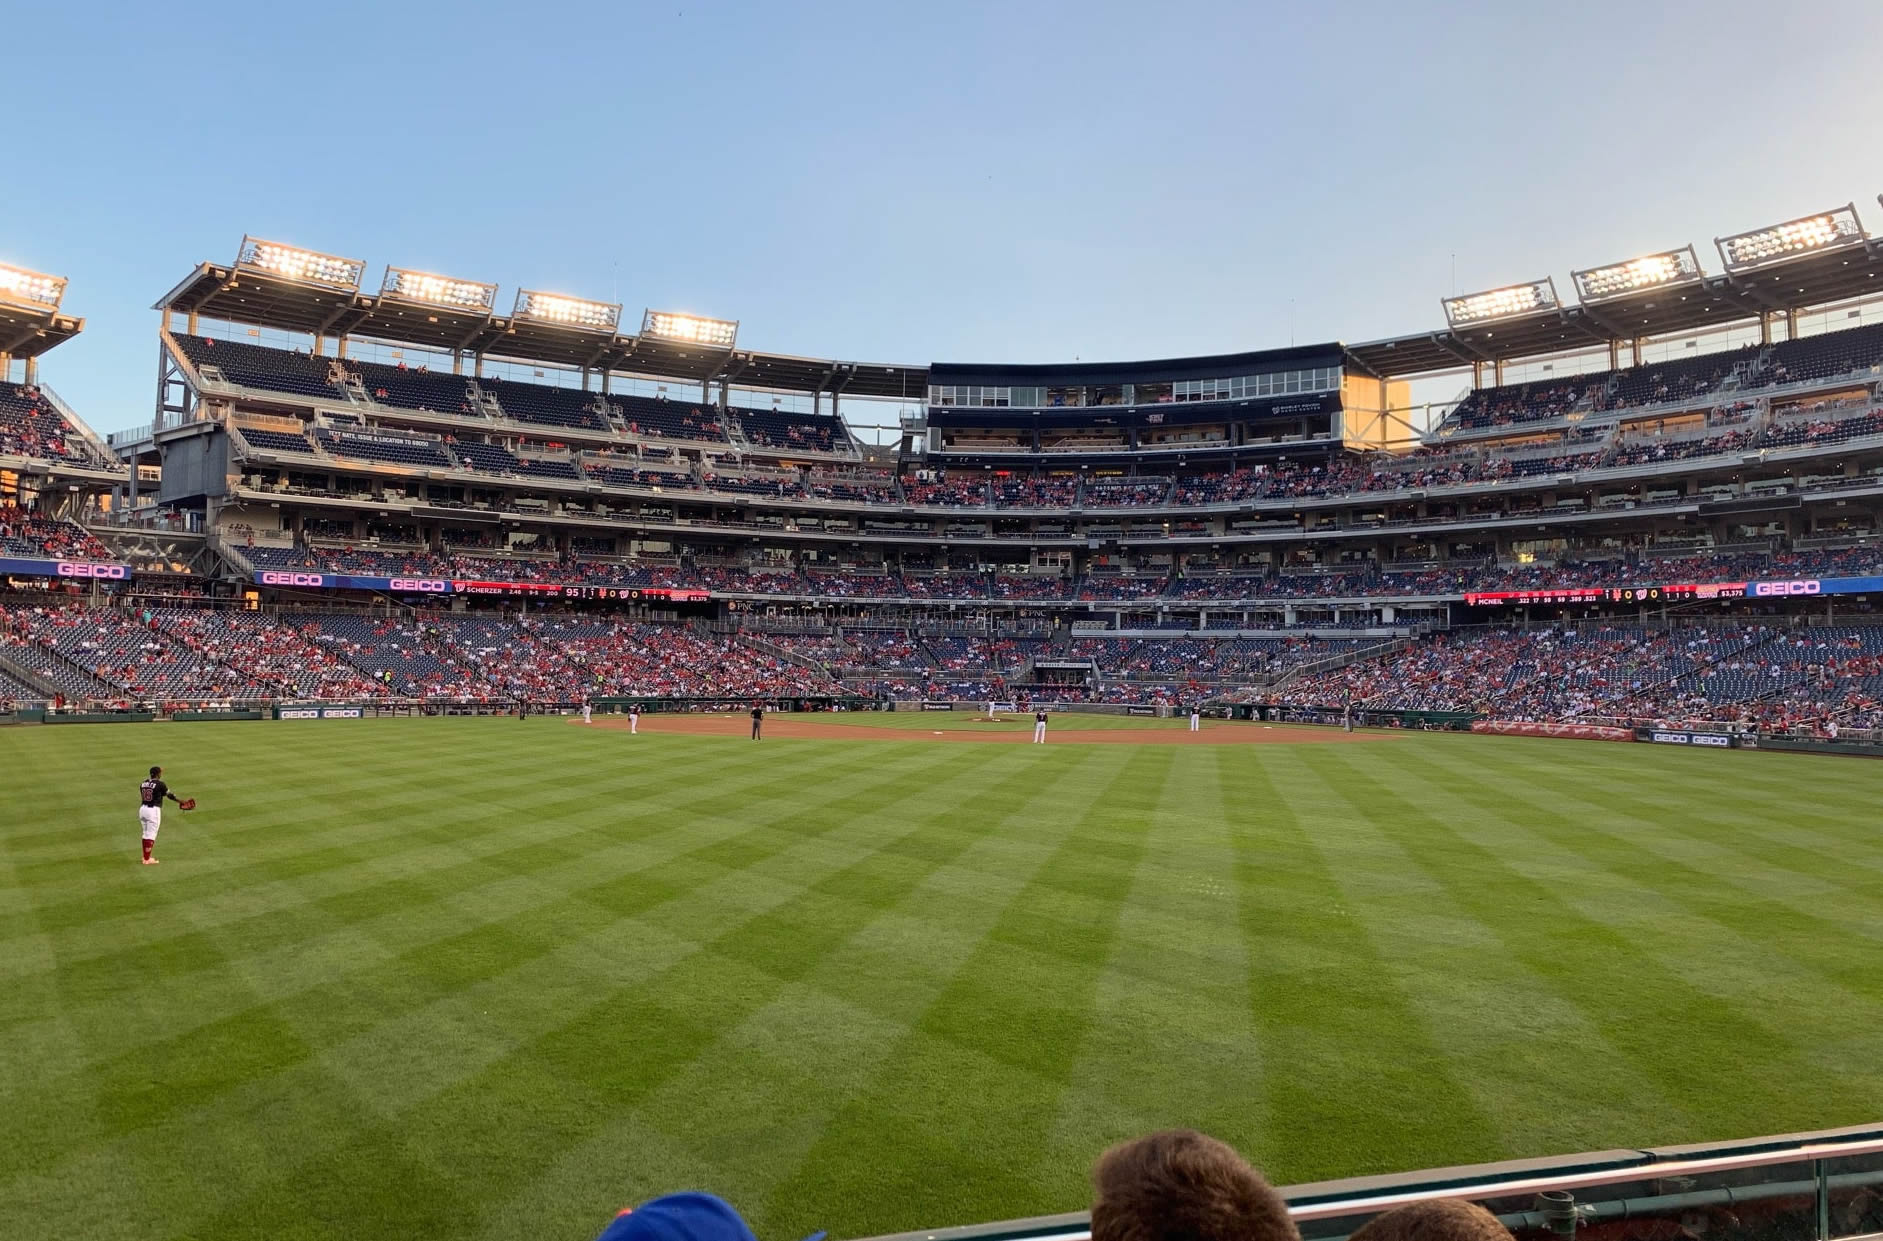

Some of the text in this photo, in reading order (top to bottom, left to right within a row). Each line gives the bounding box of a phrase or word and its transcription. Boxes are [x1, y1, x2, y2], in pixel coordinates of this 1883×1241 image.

[58, 563, 125, 578] GEICO
[262, 572, 322, 586] GEICO
[391, 579, 445, 592] GEICO
[1756, 581, 1820, 596] GEICO
[566, 588, 579, 597] 95
[609, 590, 616, 598] 0
[631, 591, 639, 599] 0
[1624, 590, 1632, 599] 0
[1650, 589, 1658, 599] 0
[737, 602, 755, 611] PNC
[1028, 609, 1047, 617] PNC
[281, 710, 359, 719] GEICO GEICO
[1654, 734, 1728, 745] GEICO GEICO
